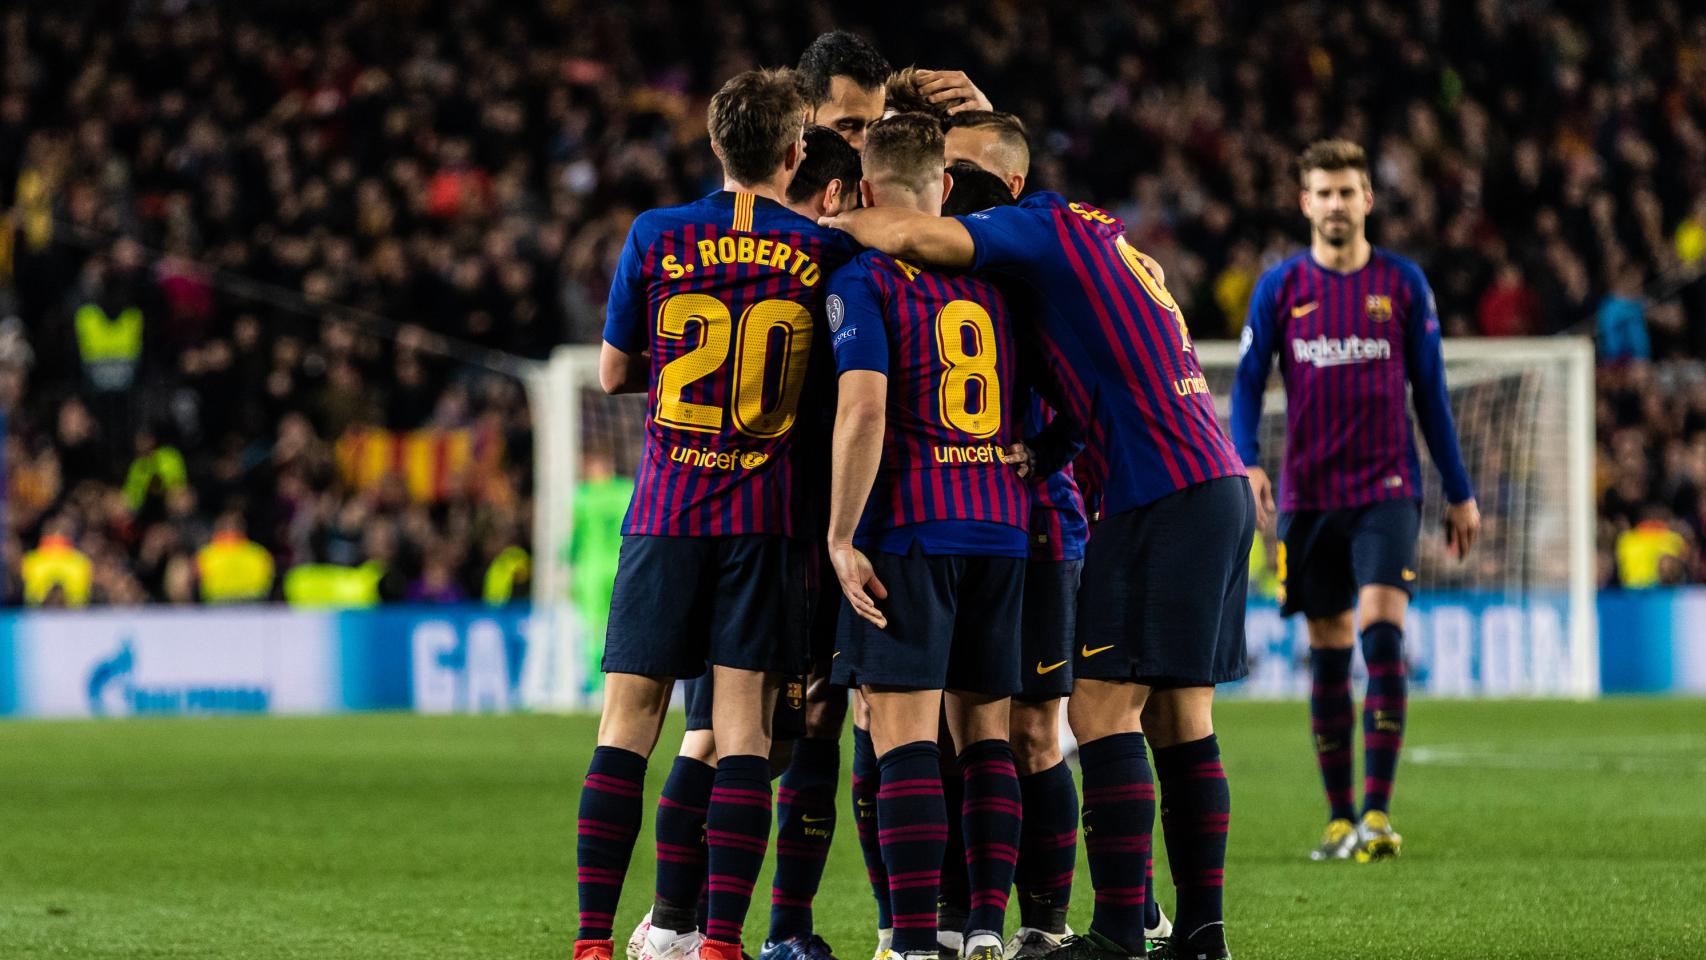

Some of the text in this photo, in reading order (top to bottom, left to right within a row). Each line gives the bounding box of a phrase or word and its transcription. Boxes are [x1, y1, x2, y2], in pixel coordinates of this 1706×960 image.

[662, 236, 822, 287] S. ROBERTO
[654, 293, 814, 439] 20
[935, 300, 1001, 439] 8
[1292, 334, 1391, 368] Rakuten
[670, 446, 740, 471] unicef
[934, 443, 994, 464] unicef
